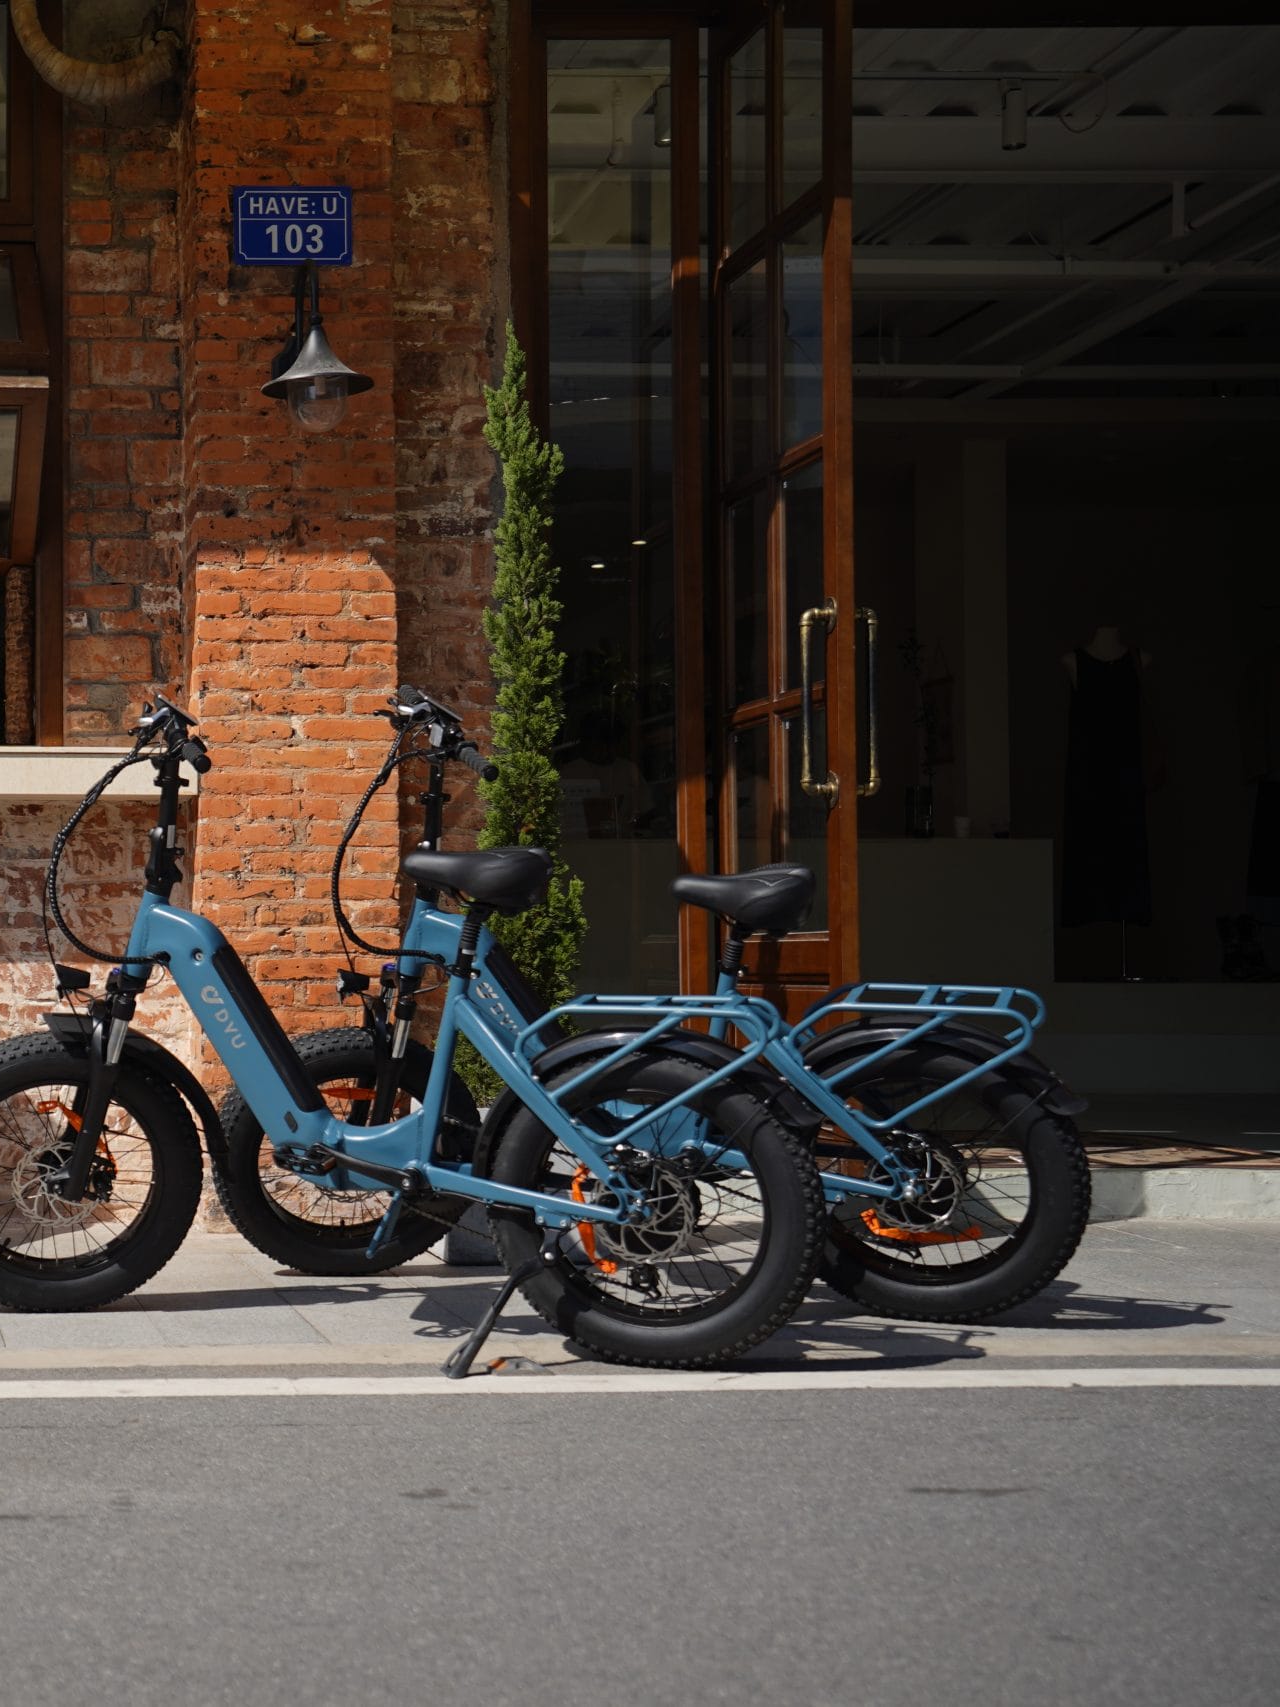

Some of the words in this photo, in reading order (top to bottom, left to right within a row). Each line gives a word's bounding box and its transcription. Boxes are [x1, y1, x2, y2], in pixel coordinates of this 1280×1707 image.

[249, 197, 316, 215] HAVE:
[322, 197, 337, 215] U
[265, 224, 324, 254] 103
[214, 1008, 247, 1049] DVU
